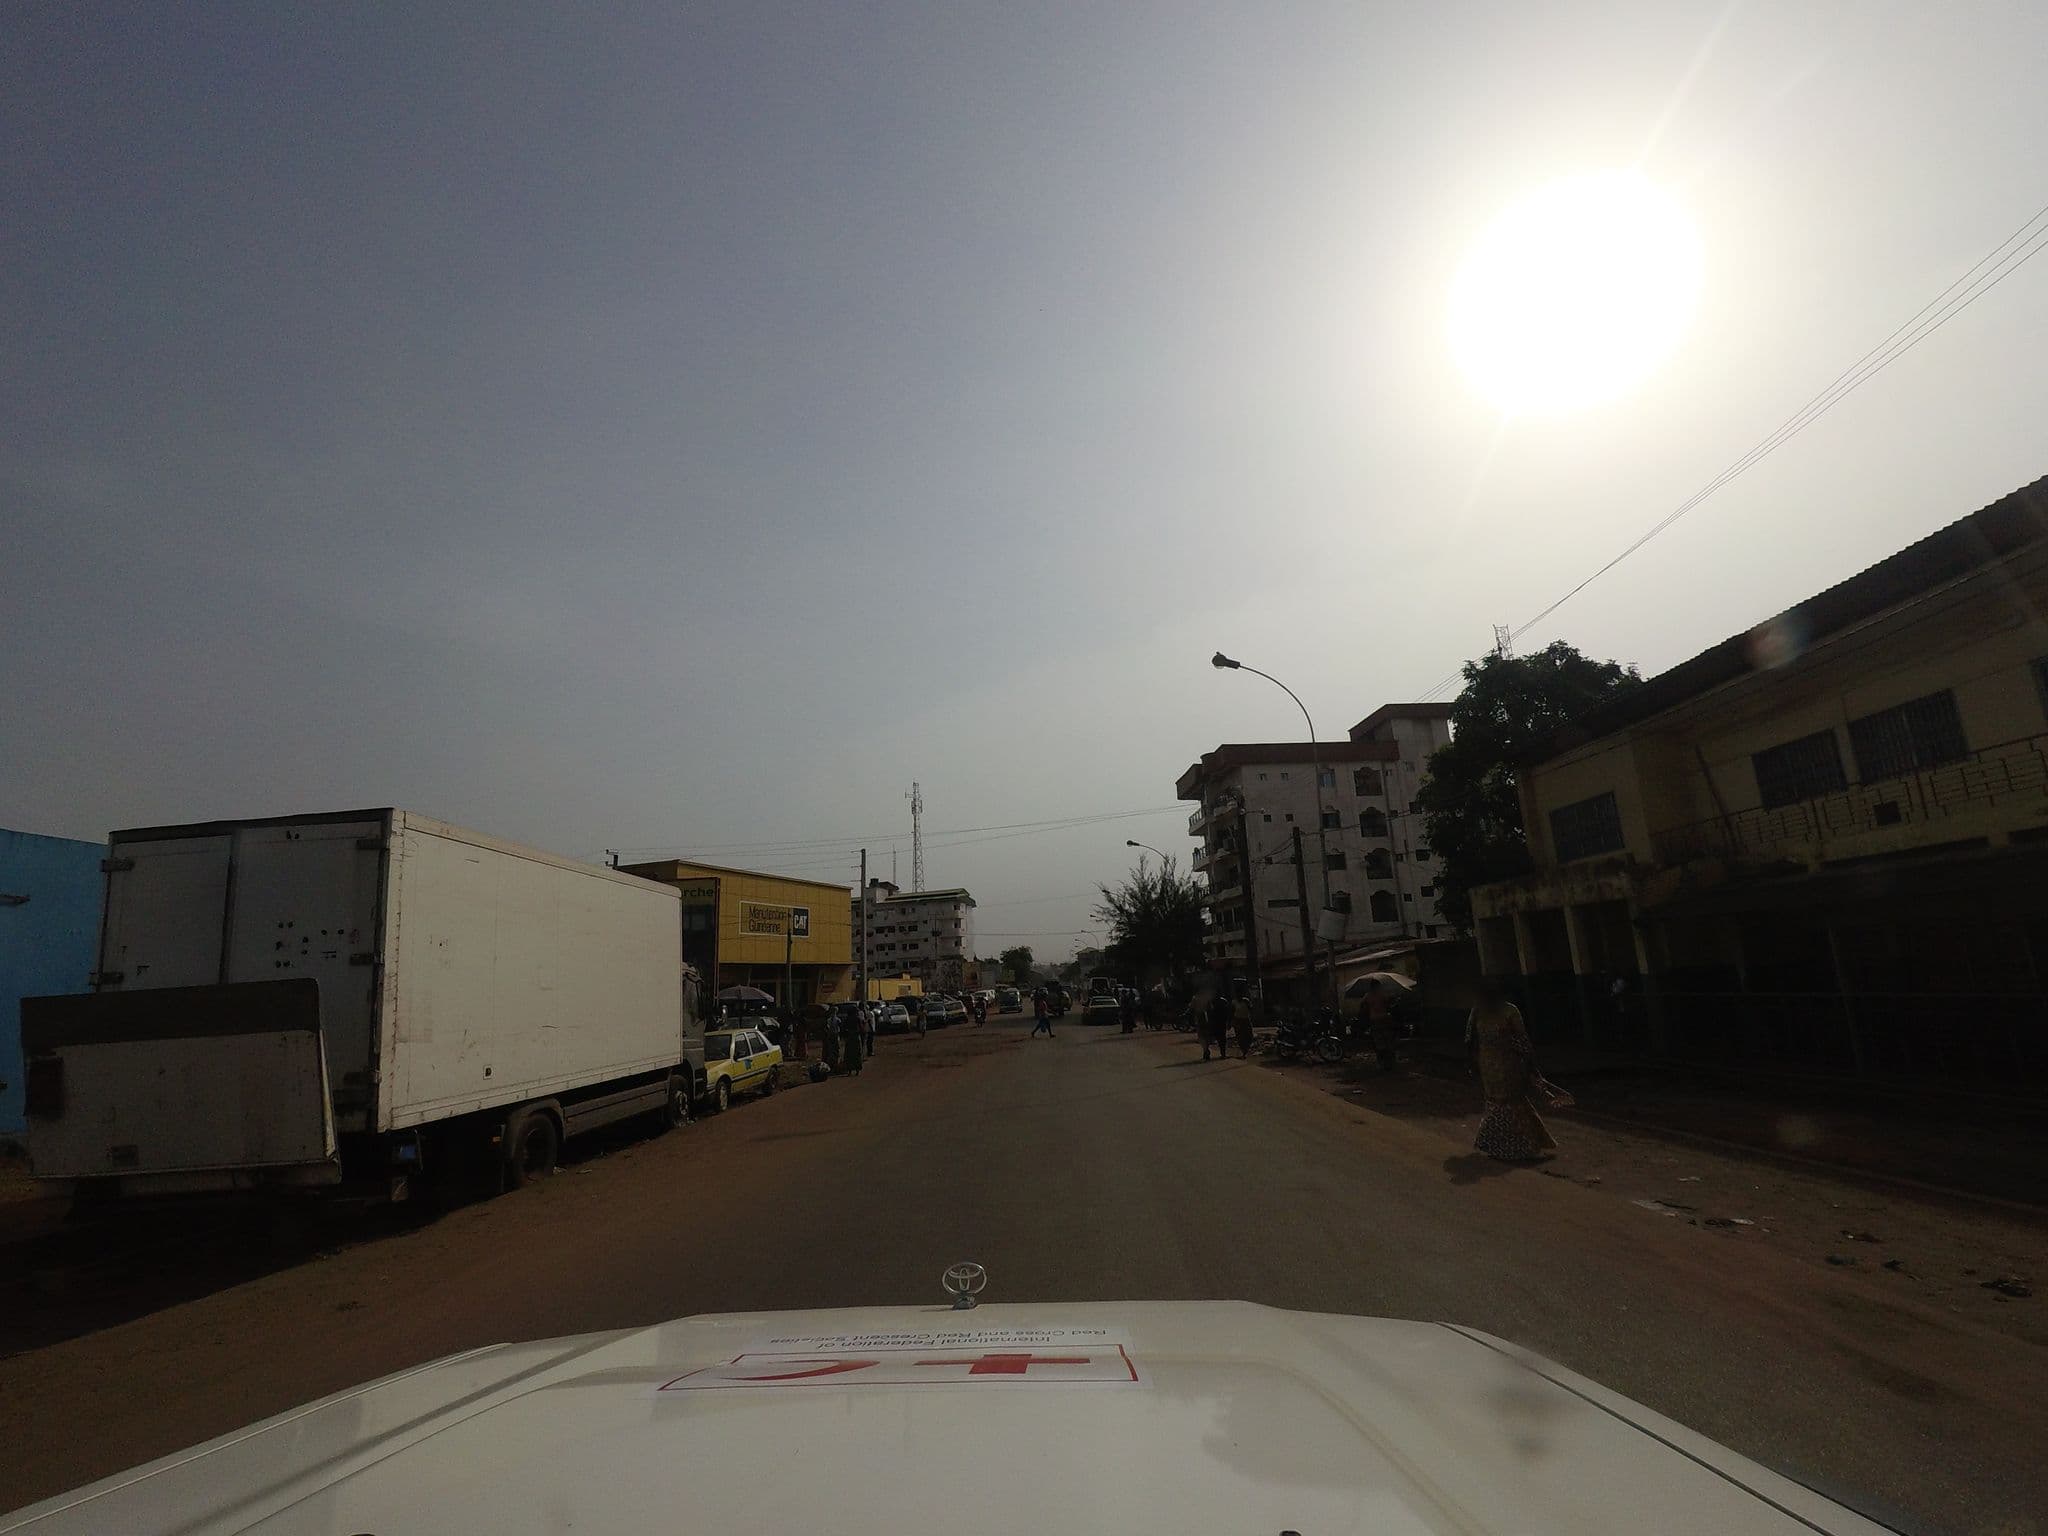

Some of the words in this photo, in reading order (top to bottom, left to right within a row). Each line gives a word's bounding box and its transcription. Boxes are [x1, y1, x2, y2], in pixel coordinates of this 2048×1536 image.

[794, 914, 808, 929] CAT
[853, 1333, 931, 1341] Crescent
[941, 1336, 1050, 1345] International
[841, 1339, 936, 1348] Federation
